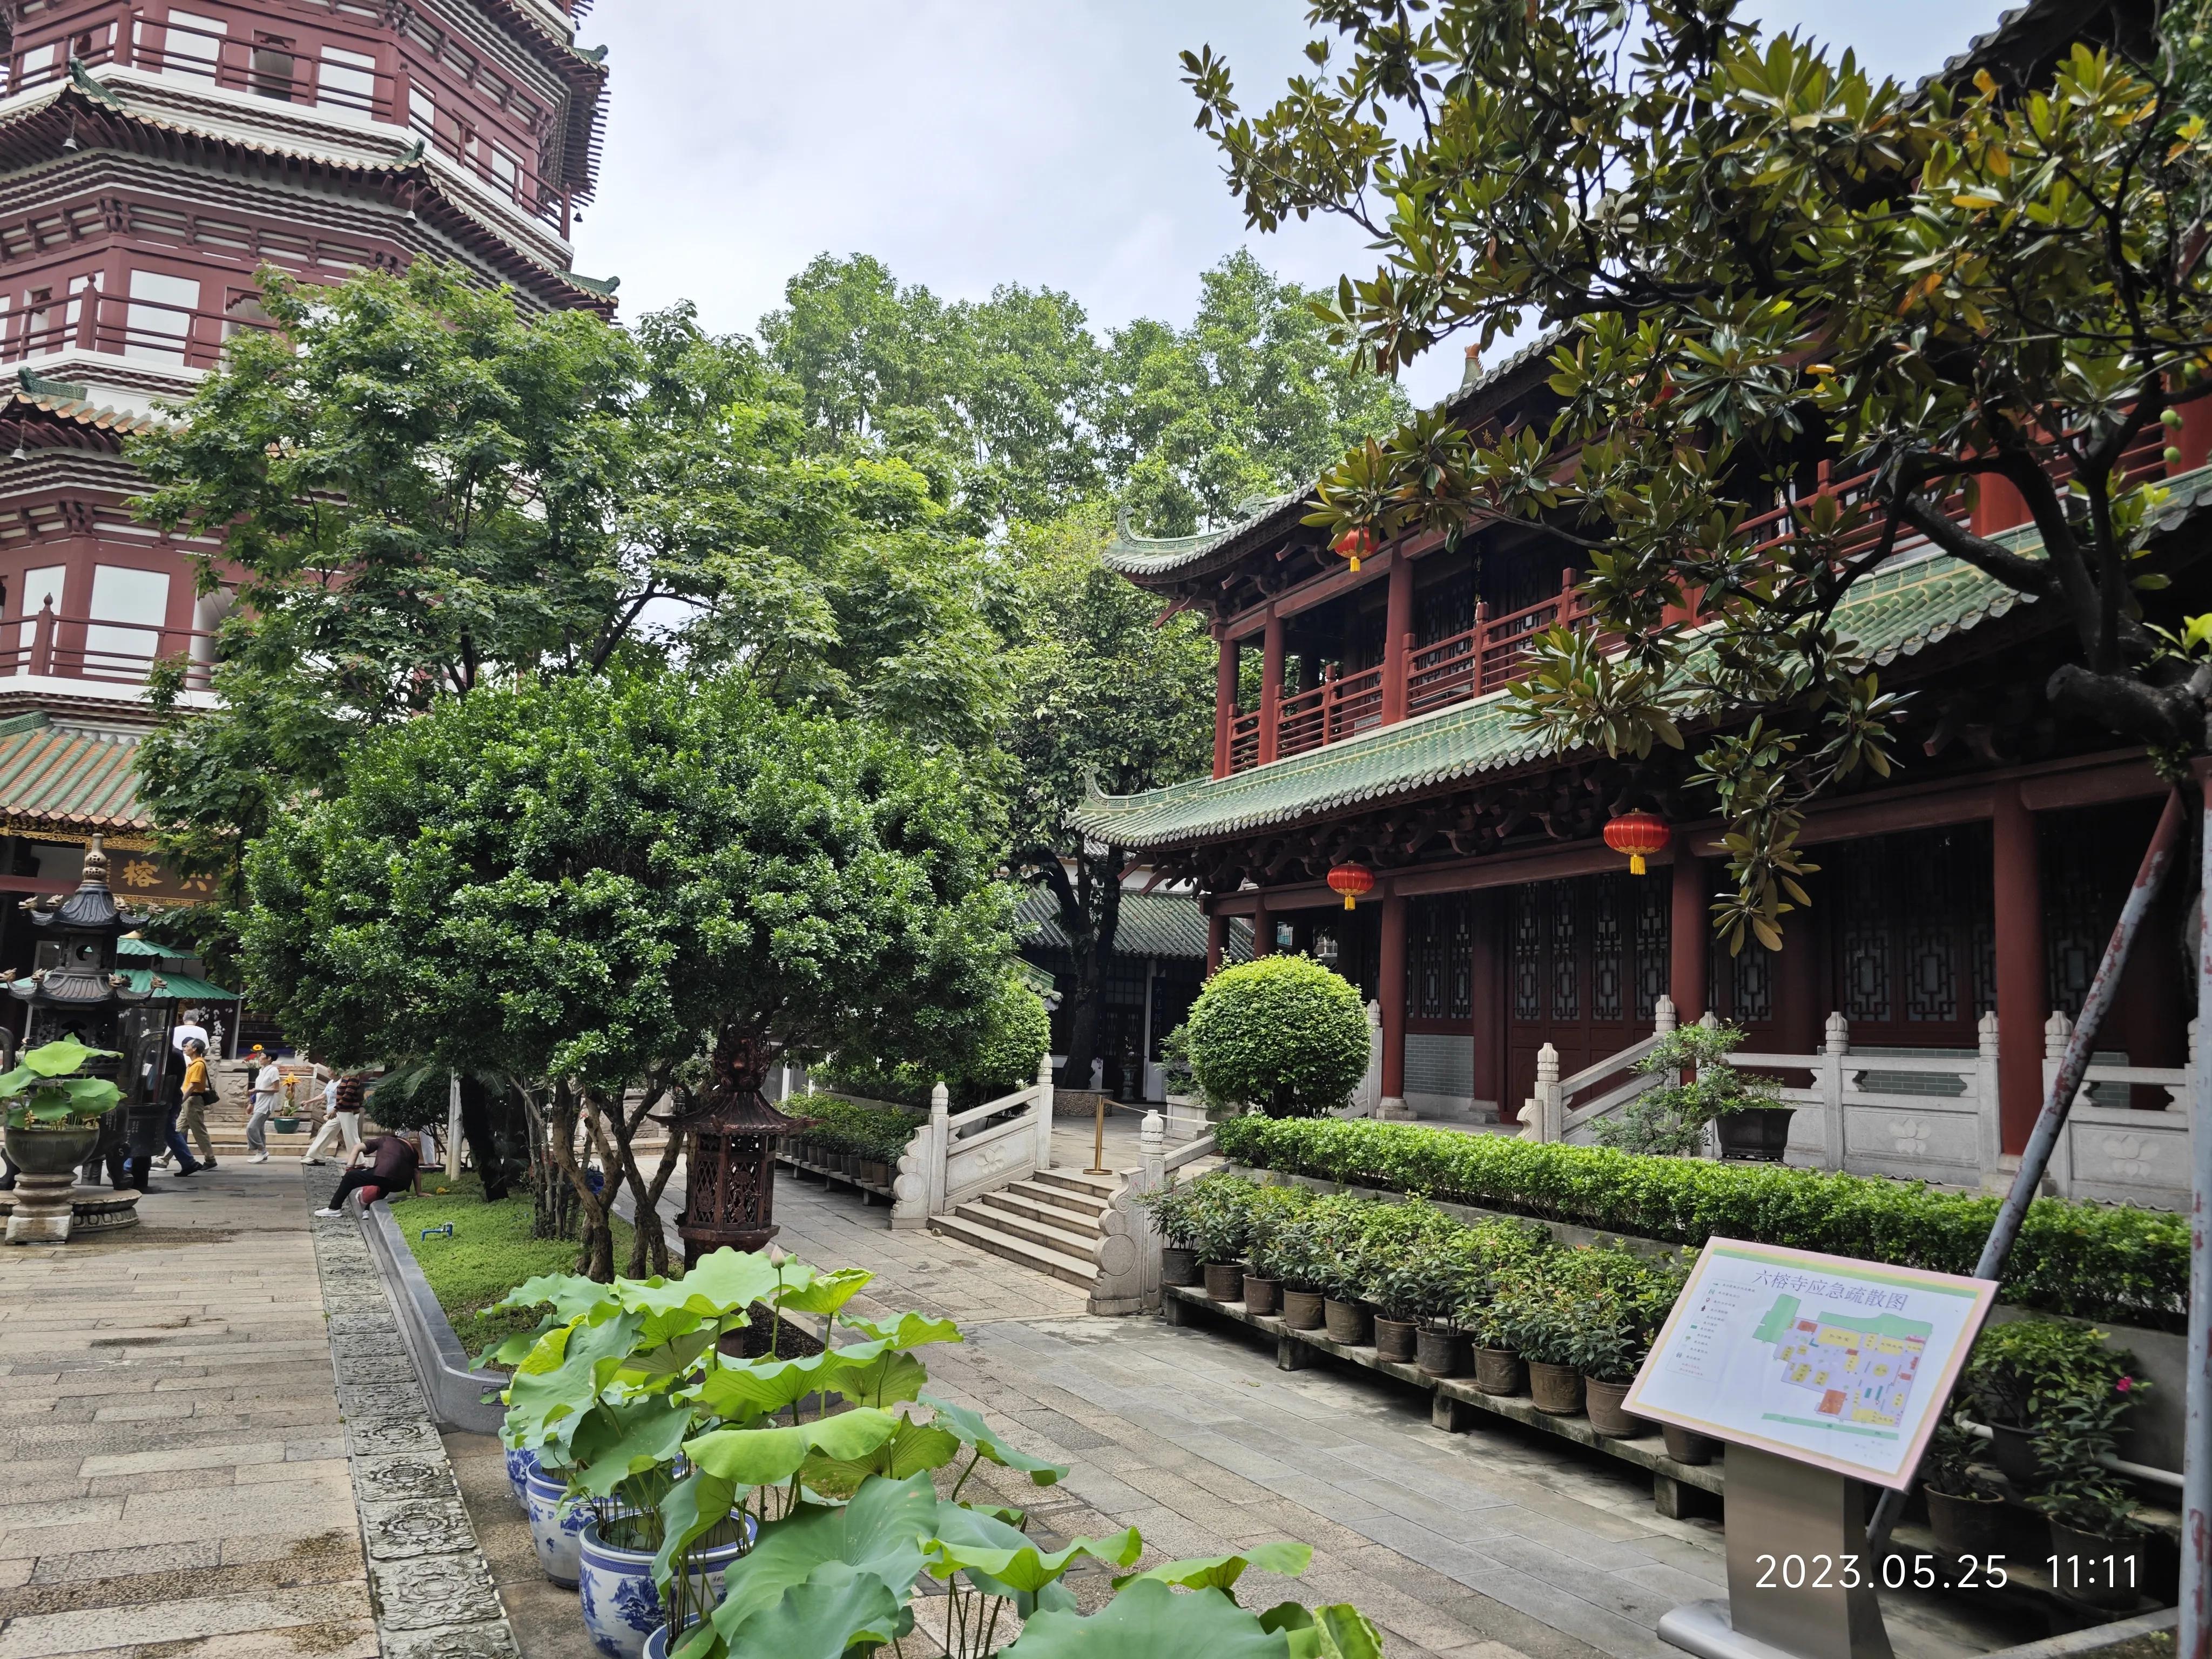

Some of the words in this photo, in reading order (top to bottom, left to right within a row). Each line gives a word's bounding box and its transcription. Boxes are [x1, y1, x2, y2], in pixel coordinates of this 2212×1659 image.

[1751, 1269, 1909, 1311] 六榕寺应急疏散图
